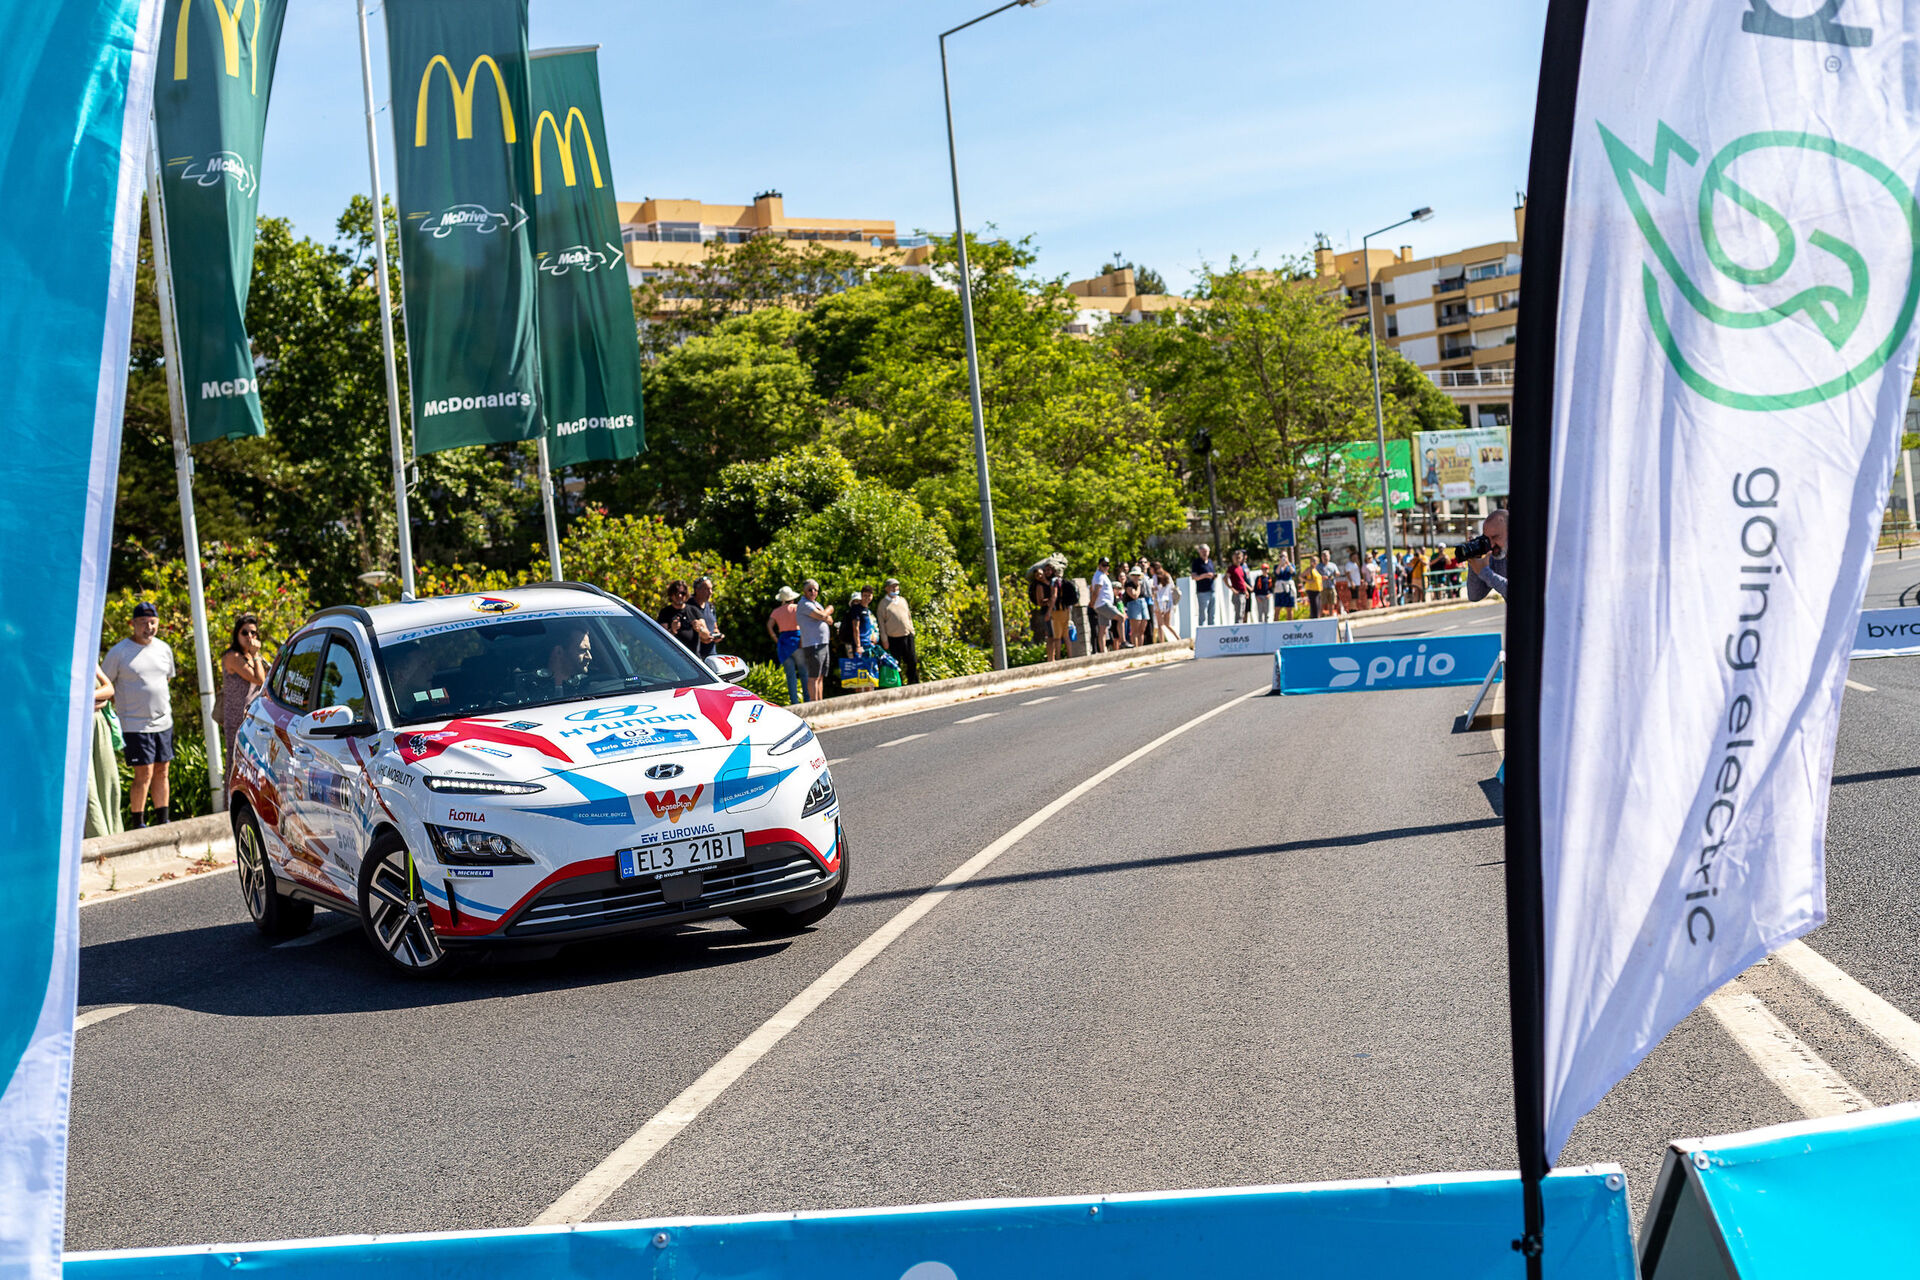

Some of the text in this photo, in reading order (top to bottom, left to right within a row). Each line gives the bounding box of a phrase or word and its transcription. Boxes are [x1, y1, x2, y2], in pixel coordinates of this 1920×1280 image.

[441, 211, 488, 226] McDrive
[424, 392, 531, 417] McDonald's
[1725, 465, 1780, 671] going
[424, 618, 490, 635] HYUNDAI
[496, 611, 560, 623] KONA
[1219, 635, 1250, 644] OEIRAS
[1282, 632, 1314, 640] OEIRAS
[1365, 643, 1456, 686] prio
[559, 713, 697, 738] HYUNDAI
[624, 728, 650, 737] 03
[387, 766, 416, 787] MOBILITY
[449, 809, 486, 822] FLOTILA
[656, 801, 692, 812] LeasePlan
[662, 823, 715, 840] EUROWAG
[1686, 697, 1755, 947] electric
[637, 848, 673, 872] EL3
